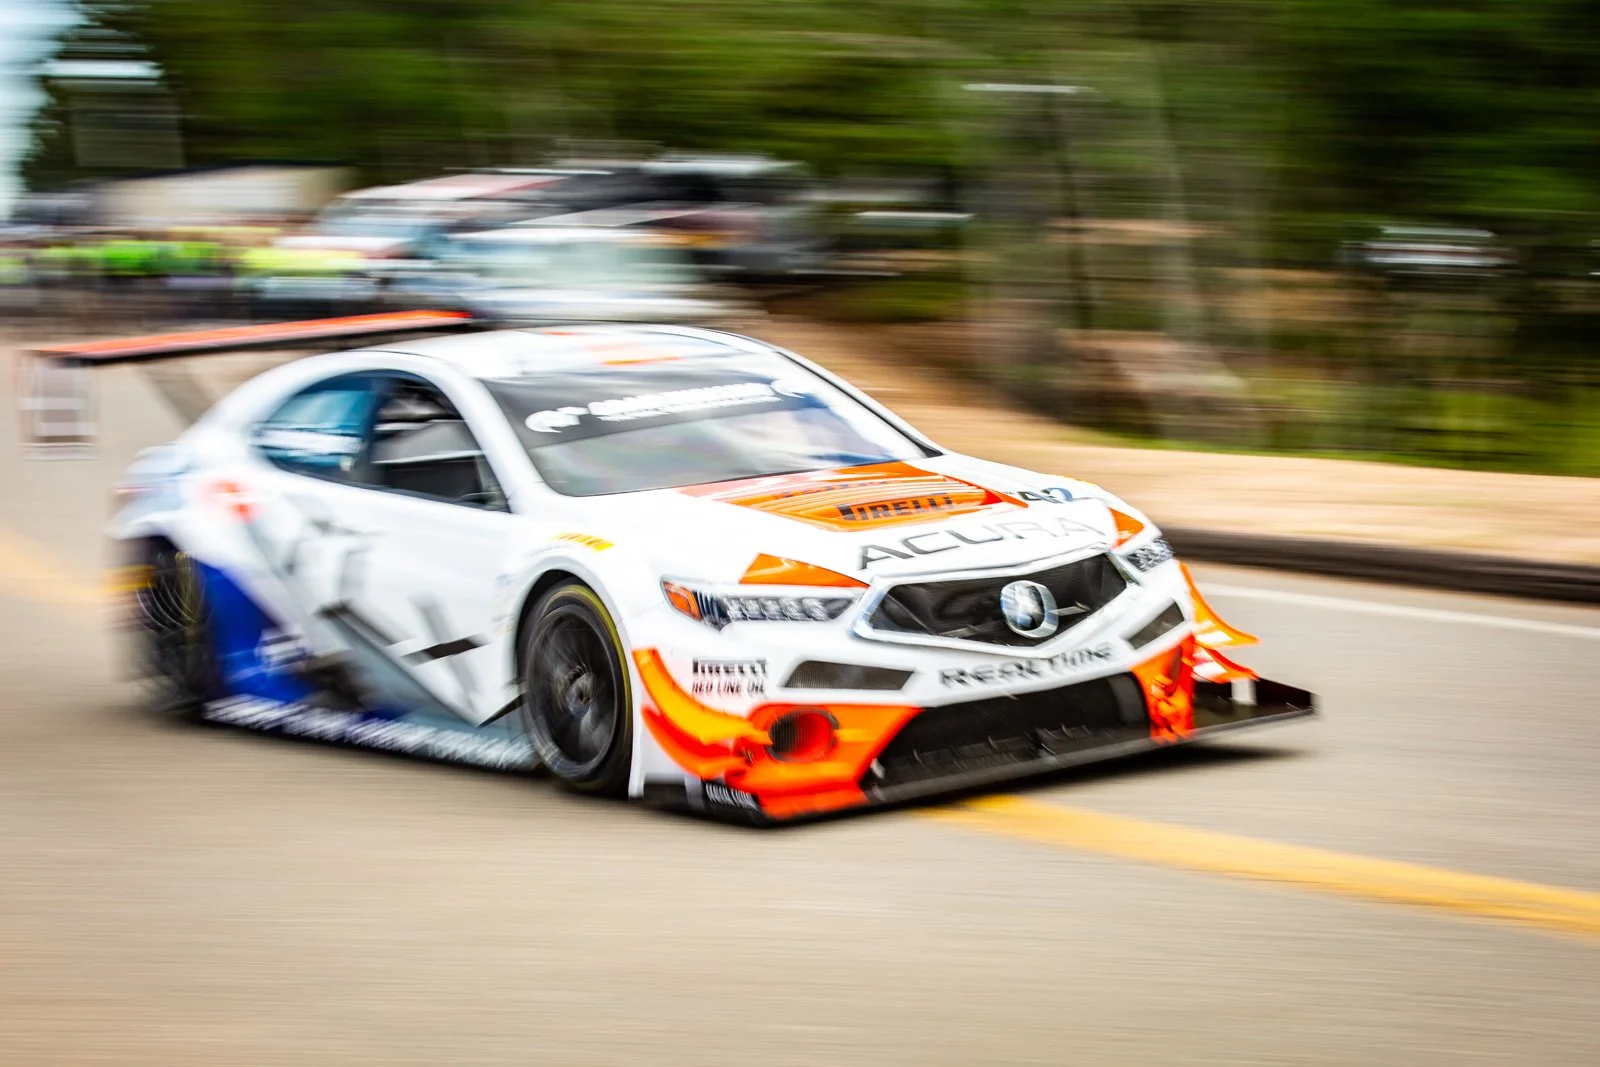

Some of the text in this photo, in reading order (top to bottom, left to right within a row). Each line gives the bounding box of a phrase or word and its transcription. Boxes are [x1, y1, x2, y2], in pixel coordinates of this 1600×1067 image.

[838, 493, 954, 521] PIRELLI
[858, 517, 1106, 570] ACURA
[692, 657, 767, 676] PIRELLI
